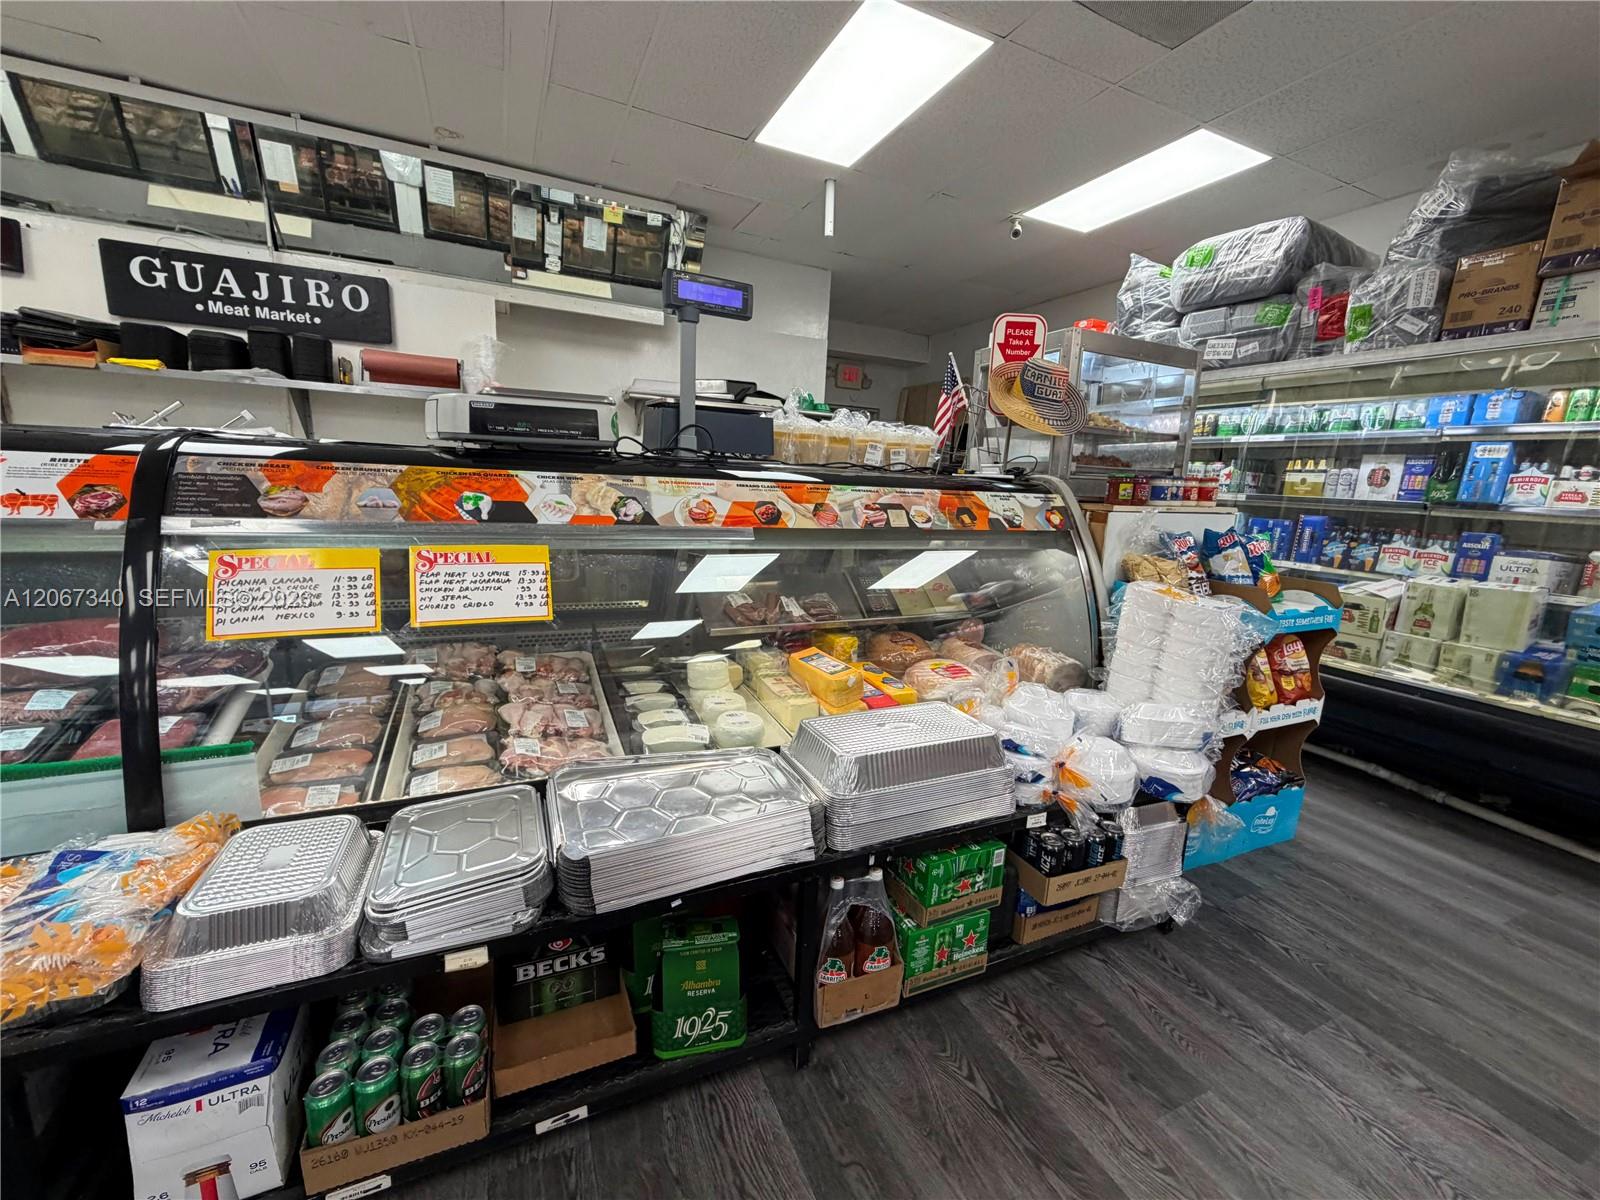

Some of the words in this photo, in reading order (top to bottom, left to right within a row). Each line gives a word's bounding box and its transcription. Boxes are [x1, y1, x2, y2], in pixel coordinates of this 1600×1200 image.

[128, 255, 371, 313] GUAJIRO
[1458, 283, 1520, 299] PRO-BRANDS
[208, 300, 250, 318] Meat
[255, 306, 312, 324] Market
[1498, 304, 1522, 315] 240
[1007, 328, 1034, 336] PLEASE
[1005, 348, 1031, 356] Number
[416, 550, 496, 572] SPECIAL
[215, 554, 317, 580] SPECIAL
[1500, 564, 1539, 574] ULTRA
[217, 579, 267, 588] PICANHA
[272, 577, 313, 585] CANADA
[215, 615, 264, 626] PICANHA
[516, 946, 606, 983] BECK'S
[681, 979, 721, 991] Alhambra
[687, 988, 716, 997] RESERVA
[673, 1007, 732, 1047] 1925
[135, 1098, 147, 1106] 12
[137, 1105, 192, 1126] Michelob
[208, 1084, 262, 1107] ULTRA
[249, 1159, 267, 1170] 95
